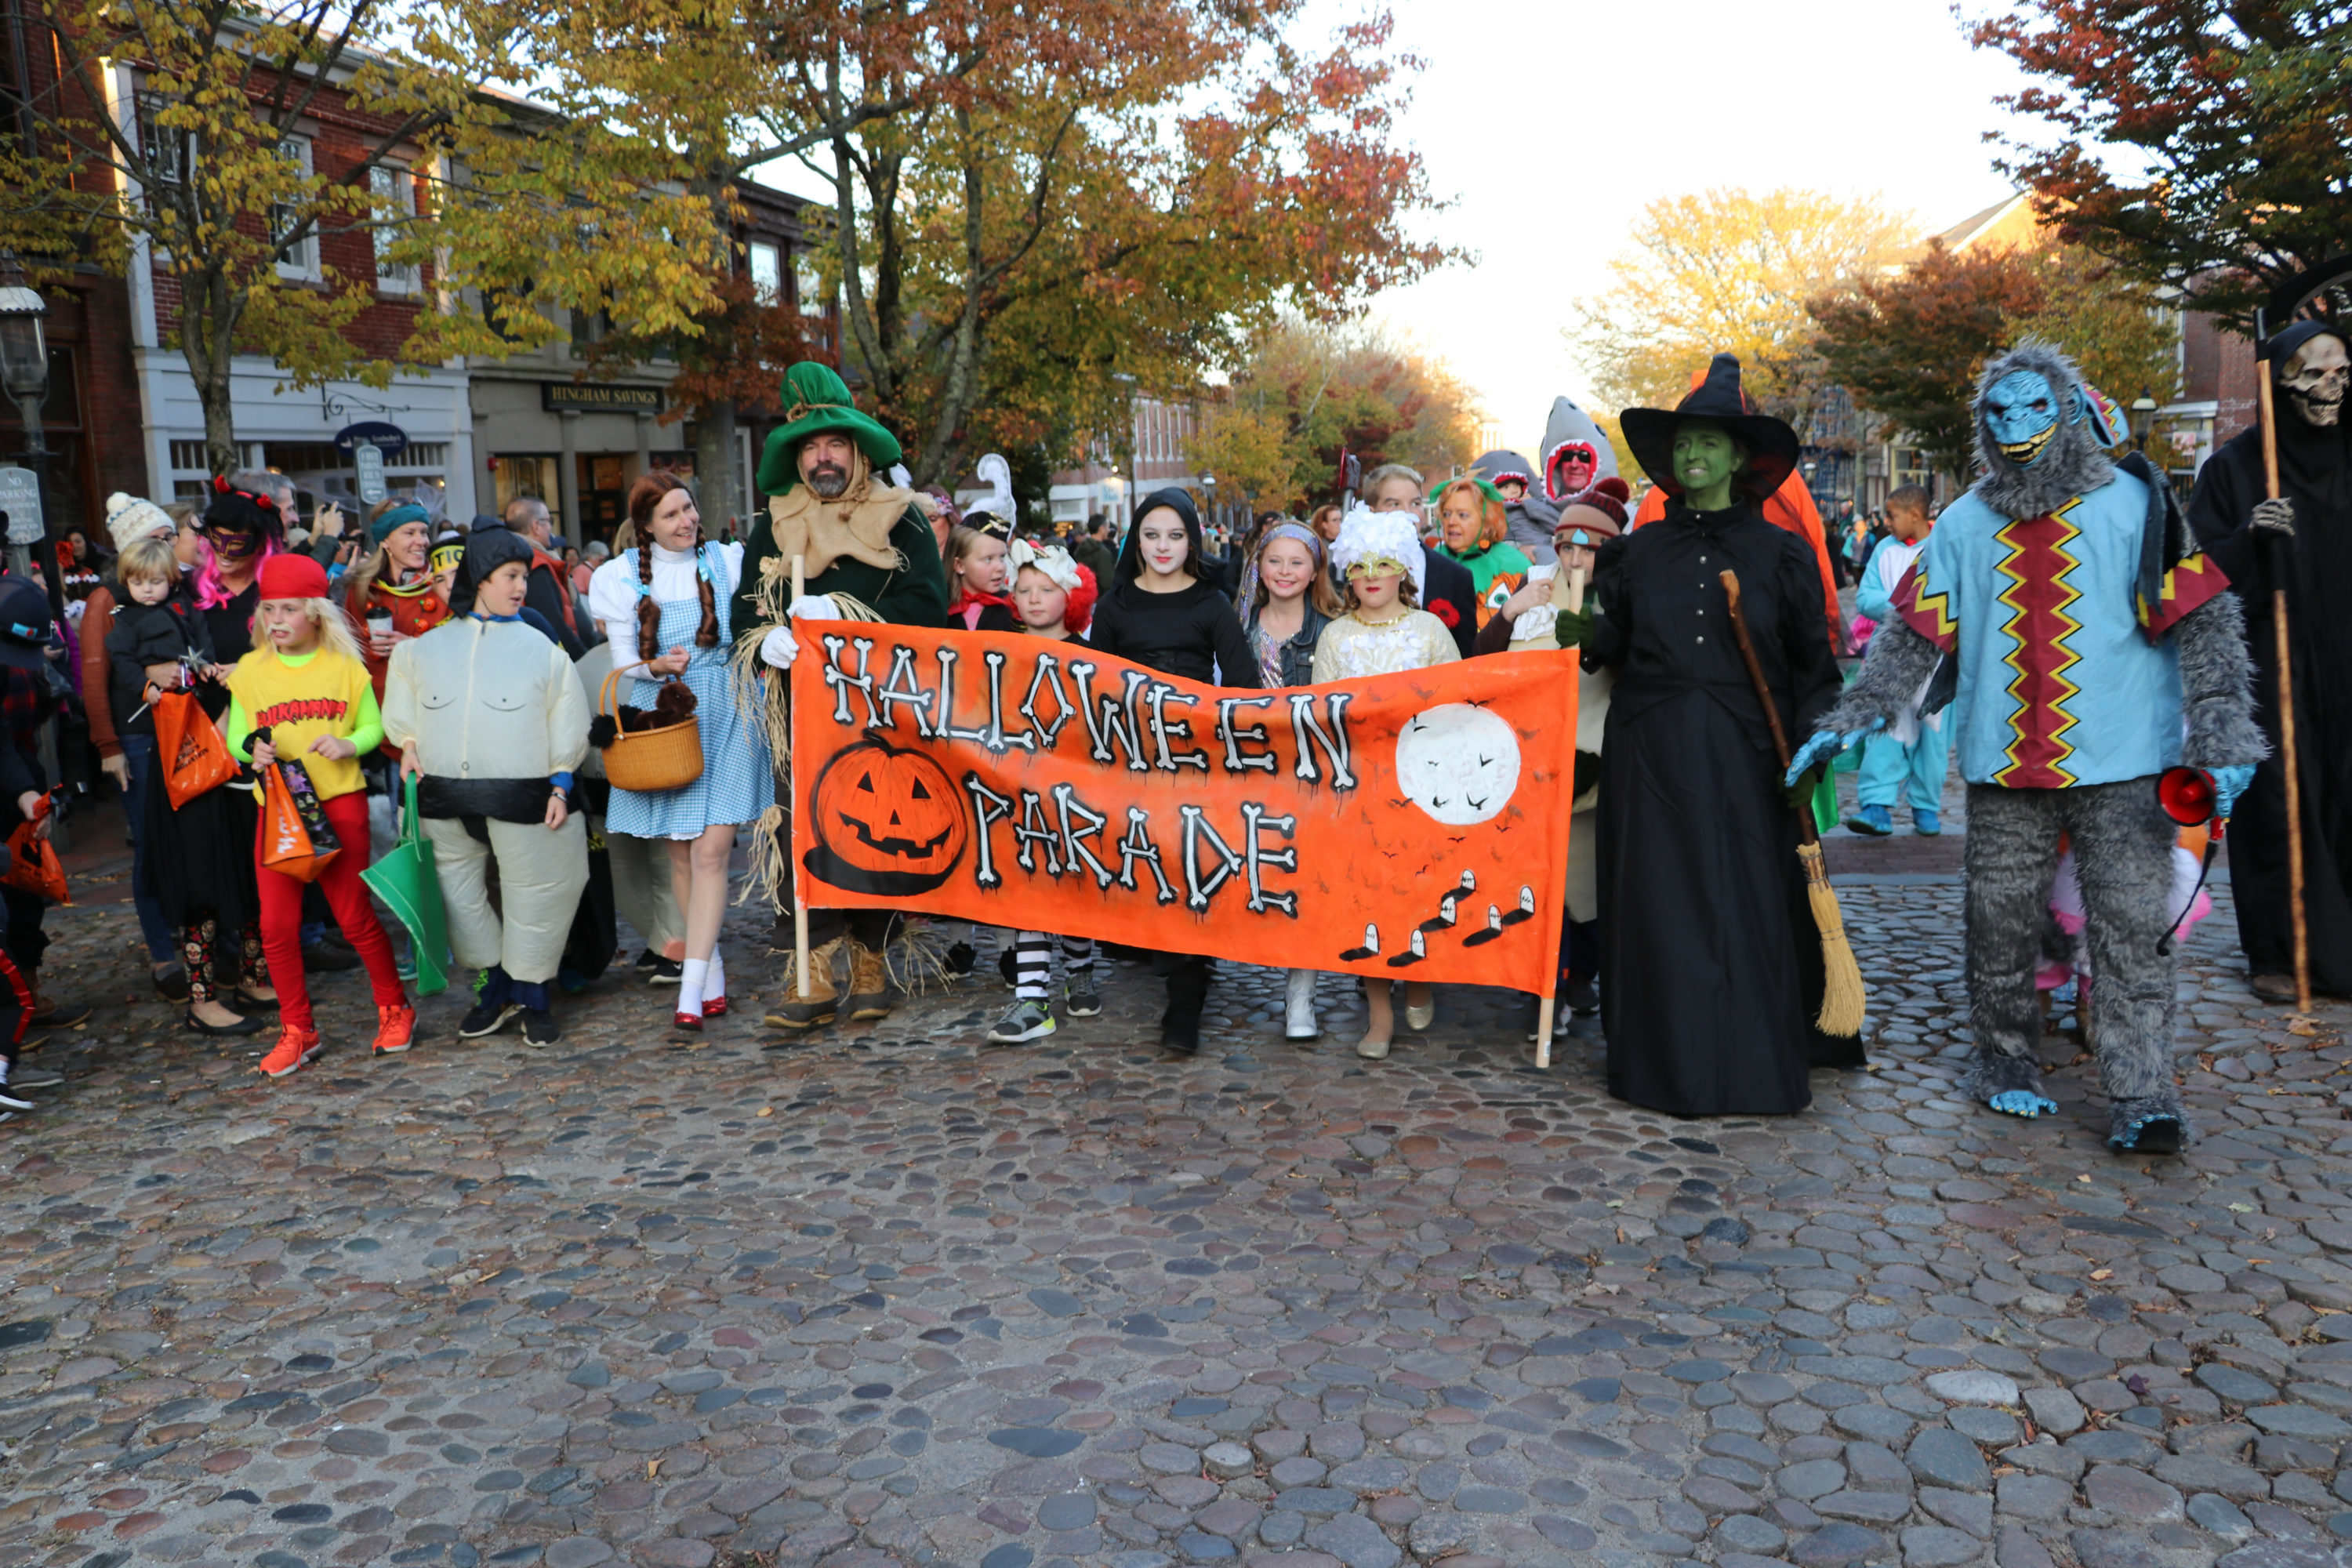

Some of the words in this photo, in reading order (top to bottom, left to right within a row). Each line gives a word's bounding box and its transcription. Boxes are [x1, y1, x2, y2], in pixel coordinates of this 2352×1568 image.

[552, 386, 610, 401] HINGHAM
[614, 389, 657, 404] SAVINGS
[8, 476, 23, 486] NO
[256, 696, 348, 729] HULKAMANIA
[820, 633, 1358, 790] HALLOWEEN
[963, 771, 1298, 919] PARADE
